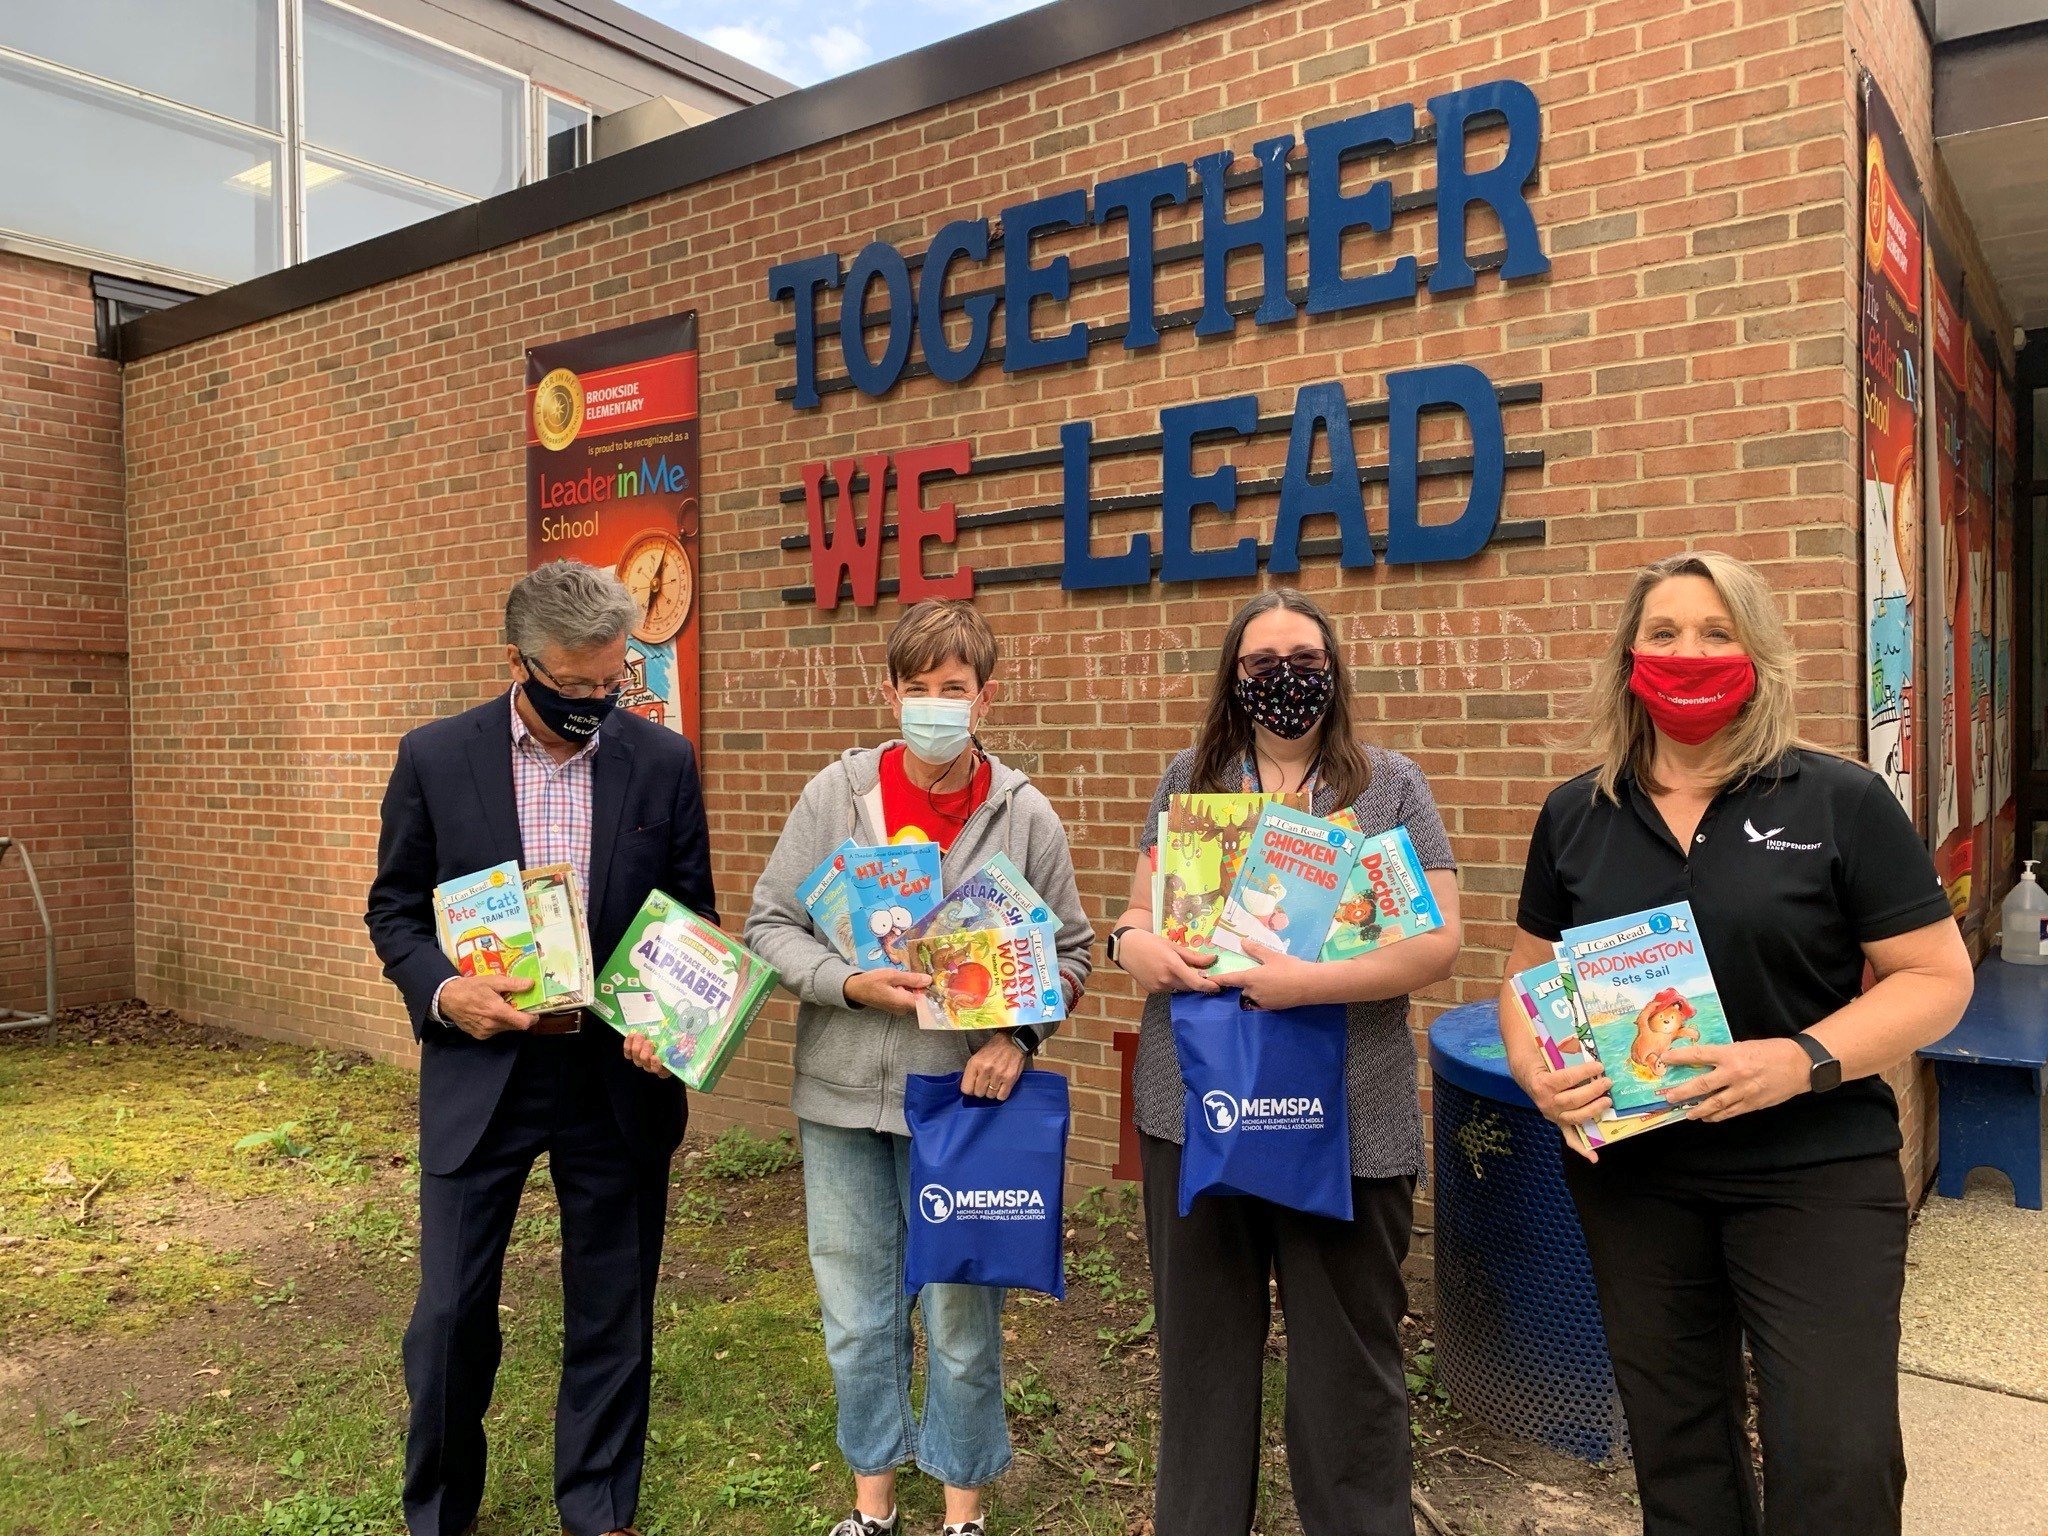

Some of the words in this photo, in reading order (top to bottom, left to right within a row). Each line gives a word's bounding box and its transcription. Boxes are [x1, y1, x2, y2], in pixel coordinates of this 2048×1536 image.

[768, 78, 1553, 410] TOGETHER
[586, 382, 640, 404] BROOKSIDE
[586, 398, 645, 420] ELEMENTARY
[588, 445, 594, 456] is
[594, 442, 614, 456] proud
[616, 442, 624, 452] to
[624, 439, 633, 450] be
[634, 432, 674, 448] recognized
[674, 434, 683, 442] as
[684, 432, 690, 440] a
[540, 468, 616, 510] Leader
[801, 439, 975, 611] WE
[1060, 363, 1506, 590] LEAD
[542, 510, 599, 542] School
[1276, 819, 1282, 830] I
[1282, 820, 1298, 834] Can
[1300, 824, 1326, 840] Read!
[1334, 832, 1340, 842] 1
[1259, 848, 1266, 857] in
[1264, 830, 1338, 866] CHICKEN
[1766, 840, 1822, 850] INDEPENDENT
[855, 861, 884, 880] HI!
[878, 868, 908, 890] FLY
[1264, 850, 1340, 891] MITTENS
[1390, 854, 1400, 872] Can
[1400, 872, 1416, 895] Read!
[454, 890, 468, 902] Can
[469, 882, 489, 898] Read!
[814, 886, 823, 898] Can
[822, 871, 836, 889] Read!
[900, 876, 932, 897] GUY
[963, 884, 1008, 908] CLARK
[1000, 876, 1014, 893] Can
[1012, 888, 1032, 910] Read!
[1360, 852, 1400, 917] Doctor
[1386, 864, 1396, 886] Want
[1394, 887, 1402, 896] to
[1398, 896, 1406, 908] Be
[448, 906, 476, 924] Pete
[476, 900, 485, 909] the
[486, 892, 518, 912] Cat's
[481, 912, 504, 924] TRAIN
[504, 906, 520, 919] TRIP
[1658, 918, 1664, 929] 1
[1586, 942, 1592, 952] I
[1594, 936, 1616, 950] Can
[1618, 925, 1647, 944] Read!
[680, 951, 702, 971] TRACE
[706, 970, 728, 989] WRITE
[1014, 938, 1038, 1000] DIARY
[1576, 939, 1694, 980] PADDINGTON
[638, 939, 732, 1012] ALPHABET
[996, 940, 1020, 1010] WORM
[1039, 964, 1050, 988] Read!
[1612, 974, 1642, 988] Sets
[1646, 966, 1670, 979] Sail
[1242, 1098, 1324, 1117] MEMSPA
[956, 1190, 1044, 1208] MEMSPA
